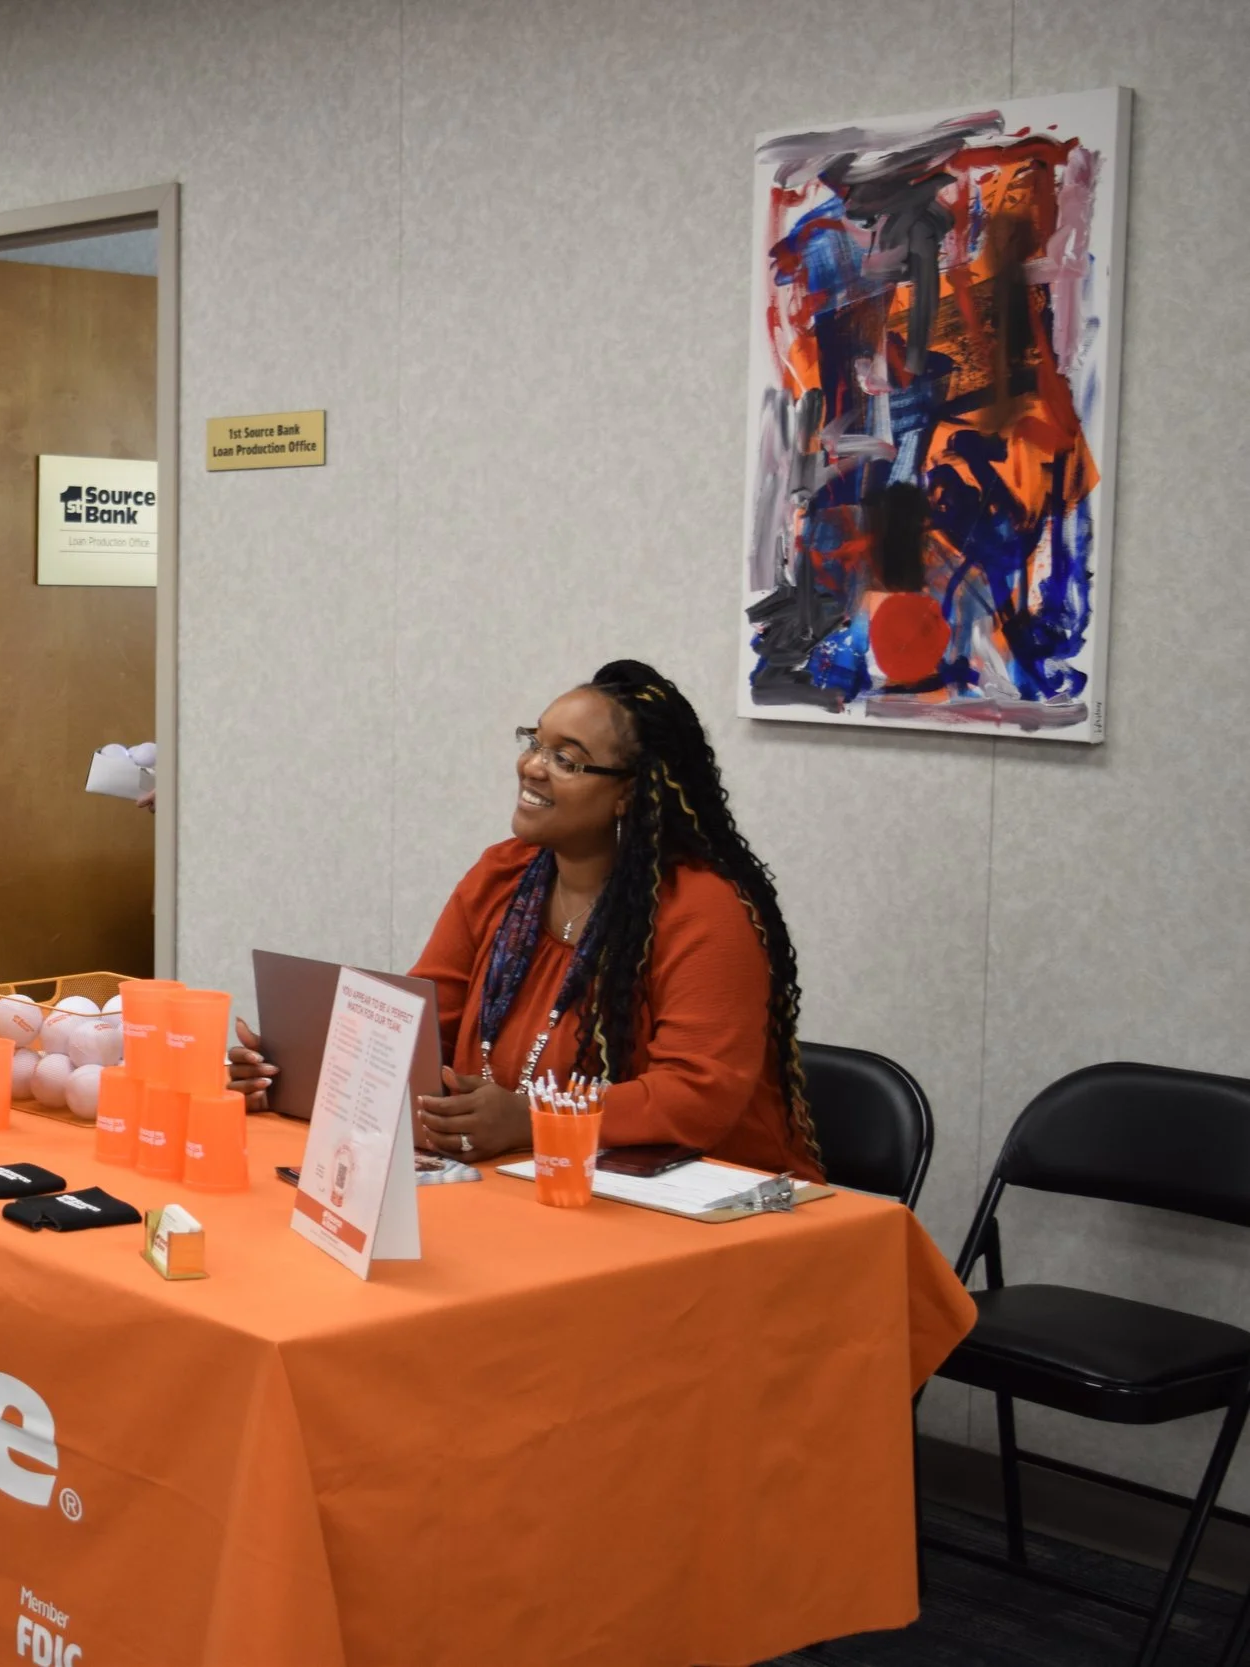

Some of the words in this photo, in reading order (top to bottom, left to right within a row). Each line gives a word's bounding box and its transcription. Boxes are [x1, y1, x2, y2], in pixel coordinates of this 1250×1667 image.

[229, 429, 242, 439] 1st
[244, 427, 275, 438] Source
[277, 424, 300, 436] Bank
[213, 446, 234, 457] Loan
[236, 442, 286, 456] Production
[288, 440, 317, 453] Office
[85, 486, 156, 506] Source
[85, 505, 138, 525] Bank
[69, 536, 86, 546] Loan
[88, 536, 127, 547] Production
[129, 537, 151, 548] Office
[20, 1585, 70, 1629] Member
[17, 1614, 82, 1667] FDIC
